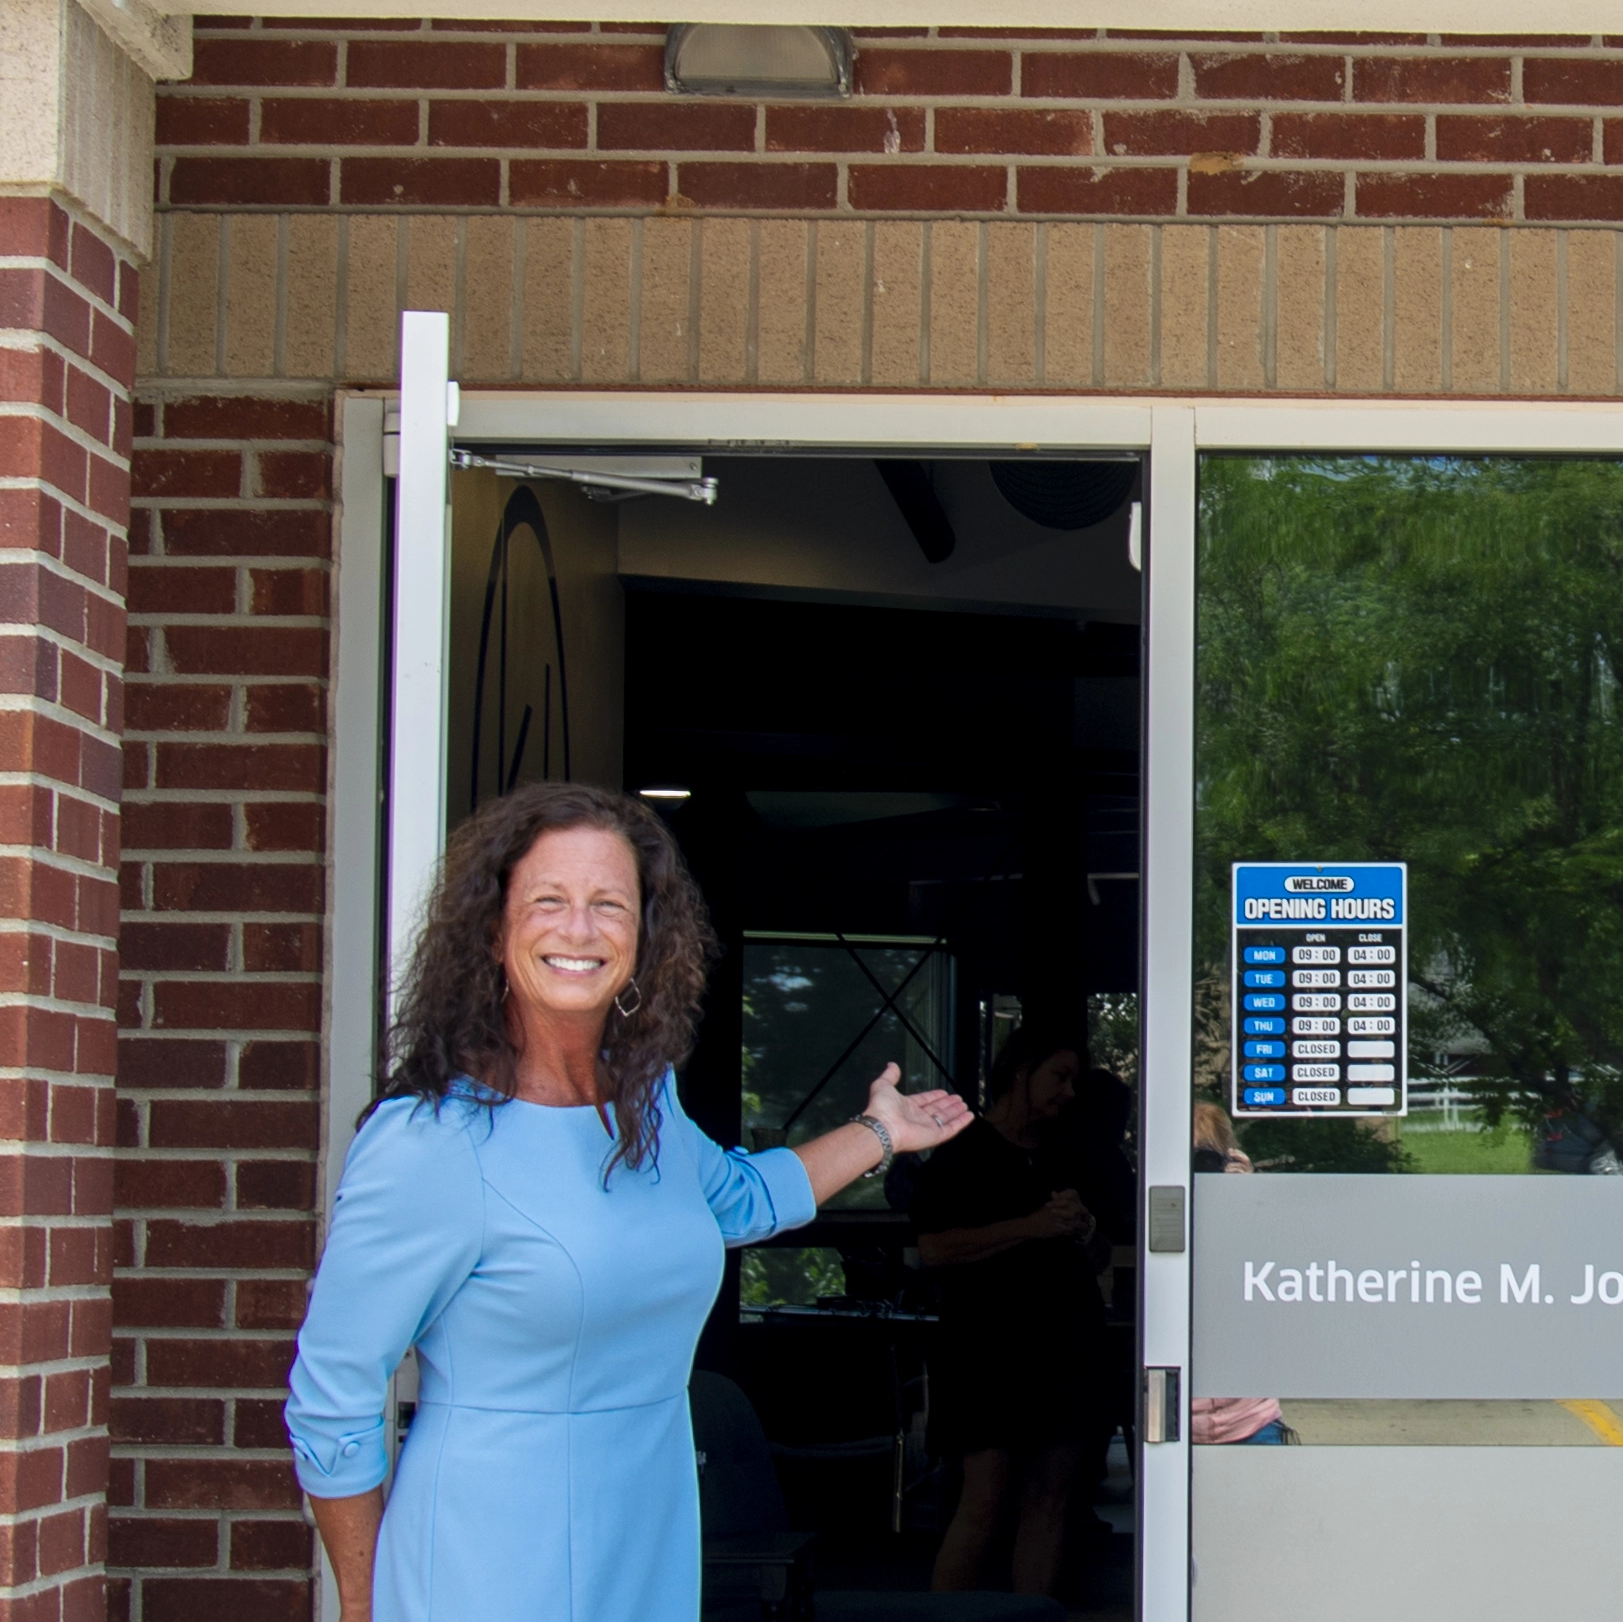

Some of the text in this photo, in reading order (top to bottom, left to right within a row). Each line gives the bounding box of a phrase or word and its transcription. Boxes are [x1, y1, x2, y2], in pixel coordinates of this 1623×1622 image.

[1292, 878, 1348, 890] WELCOME
[1244, 897, 1395, 920] OPENING HOURS
[1305, 933, 1383, 943] OPEN CLOSE
[1253, 950, 1276, 961] MON
[1254, 973, 1273, 984] TUE
[1253, 997, 1275, 1008] WED
[1253, 1021, 1273, 1032] THU
[1256, 1043, 1336, 1055] FRI CLOSED
[1254, 1067, 1335, 1078] SAT CLOSED
[1253, 1091, 1336, 1102] SUN CLOSED
[1244, 1260, 1482, 1304] Katherine
[1500, 1263, 1554, 1305] M.
